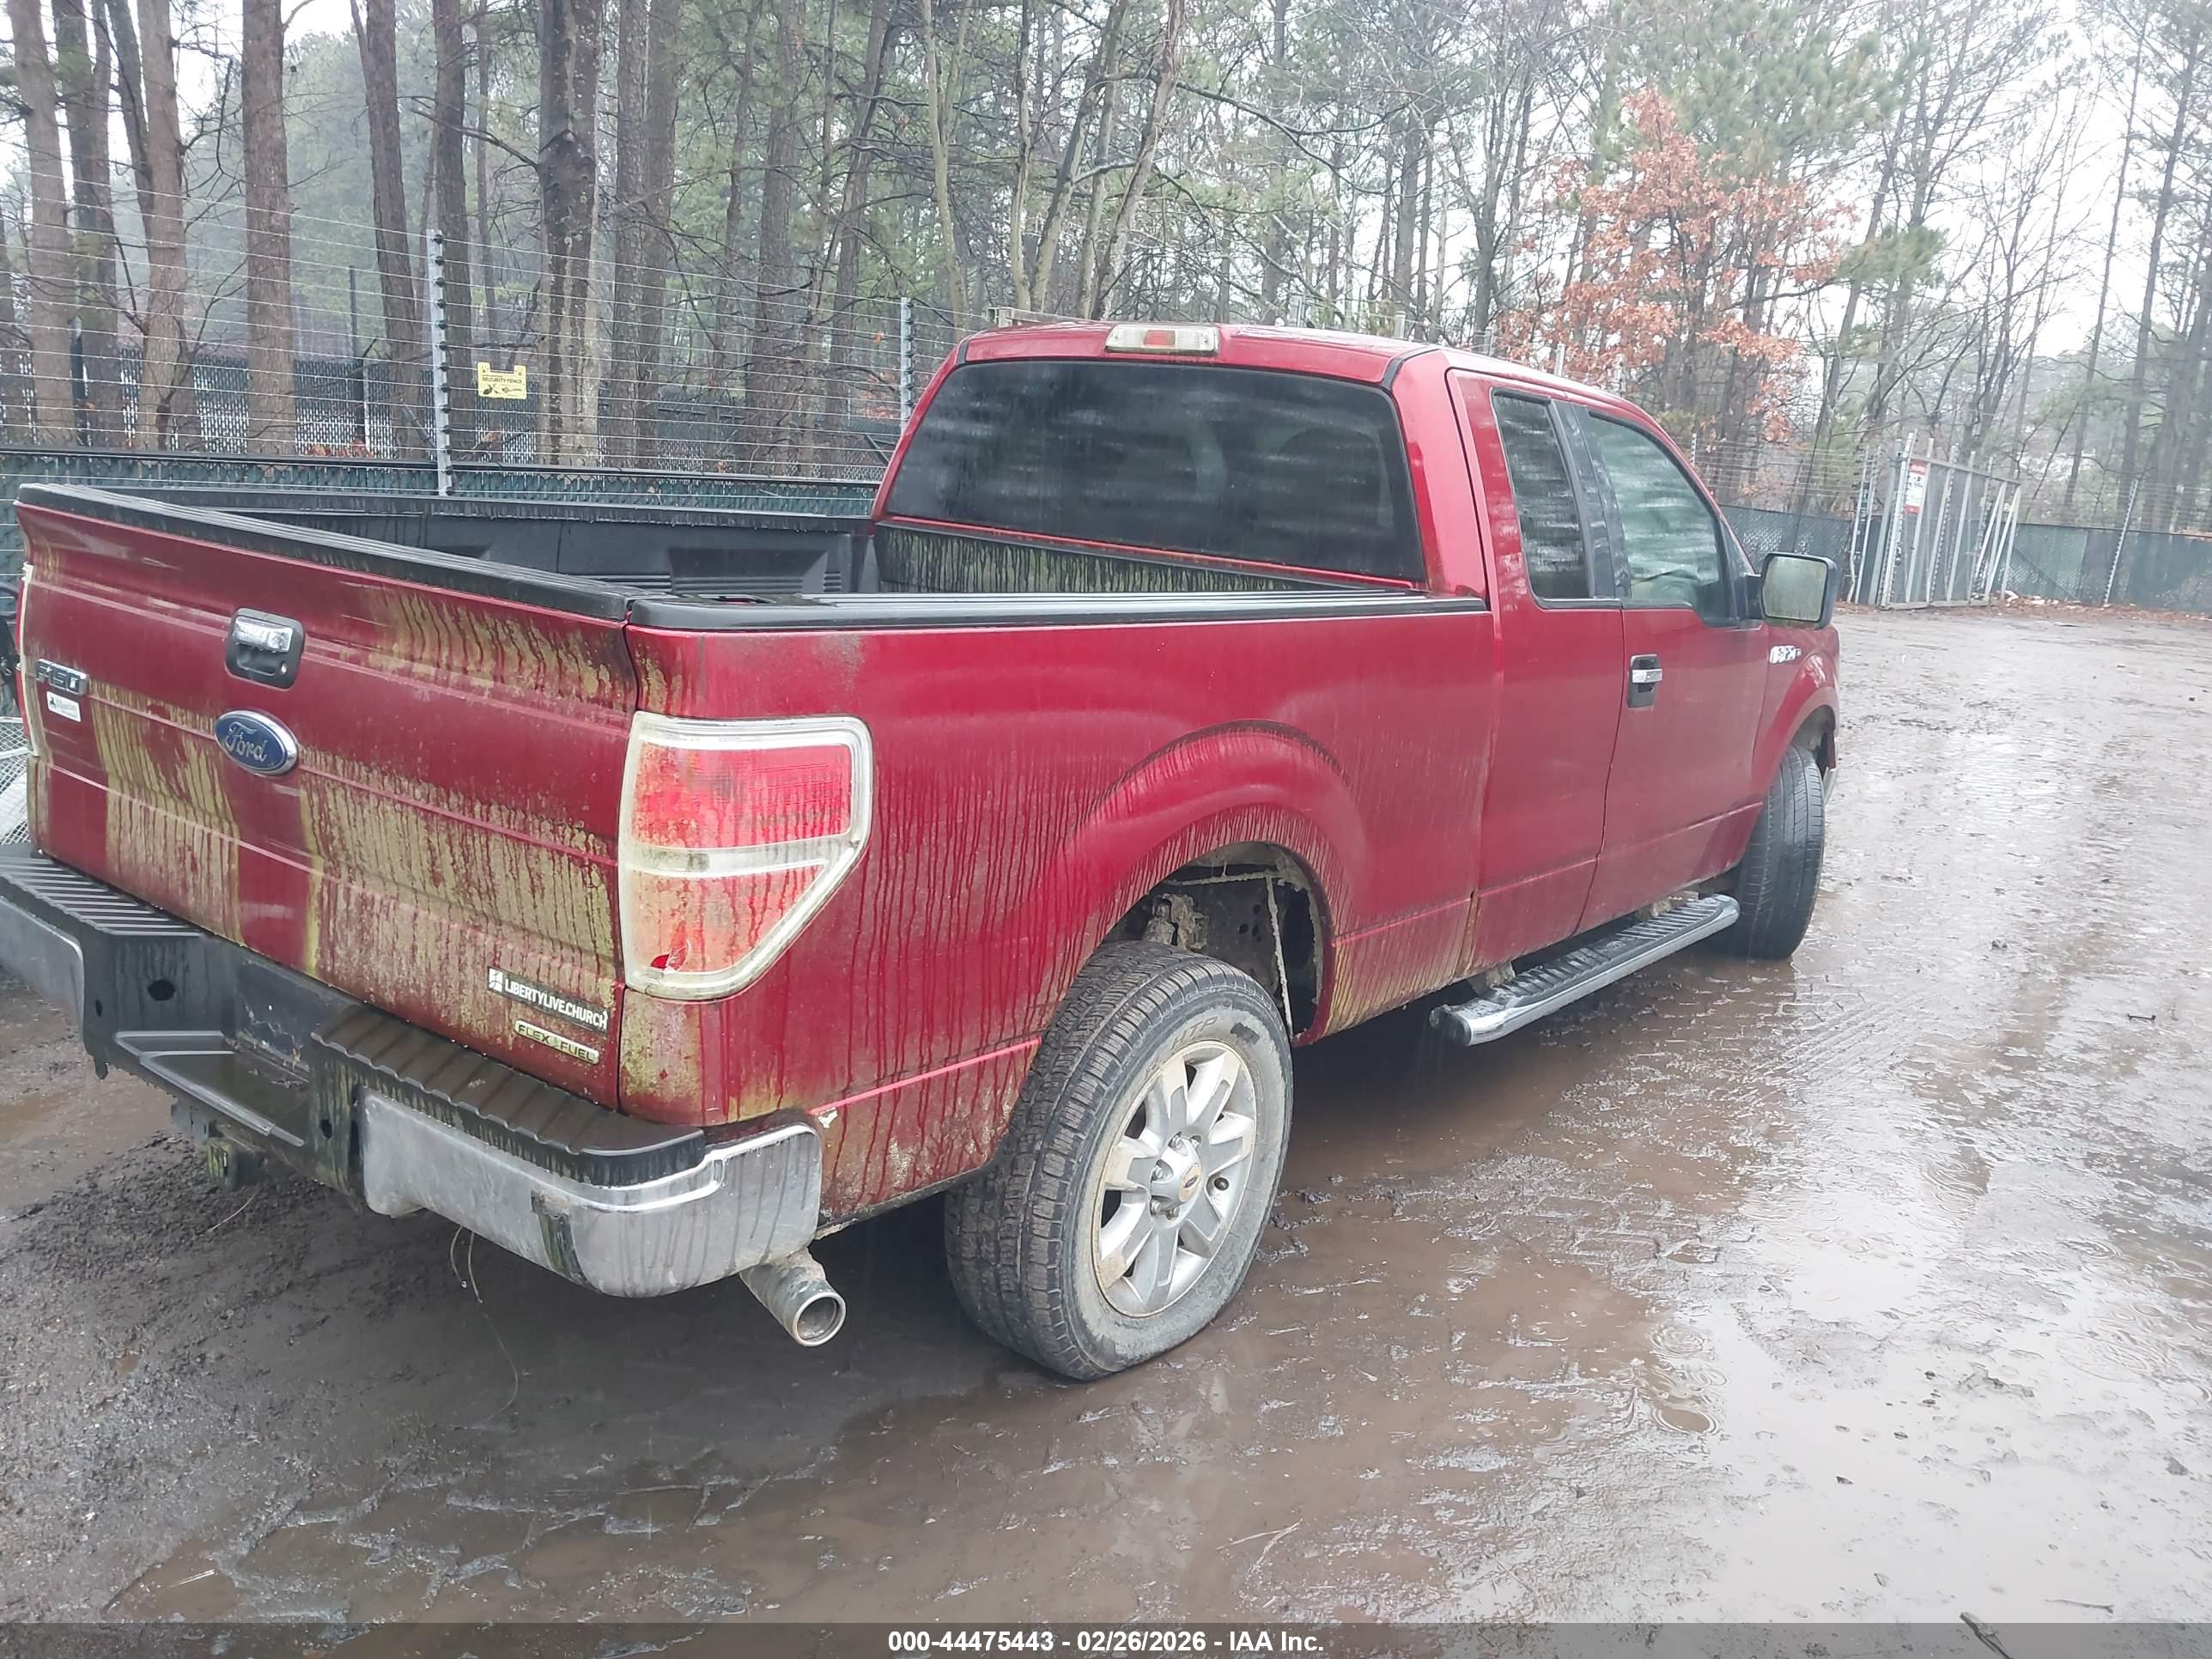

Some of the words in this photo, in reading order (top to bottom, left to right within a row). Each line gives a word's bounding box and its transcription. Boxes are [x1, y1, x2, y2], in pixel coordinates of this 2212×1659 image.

[225, 721, 268, 763] Ford
[518, 1024, 550, 1045] FLEX
[559, 1041, 595, 1062] FUEL
